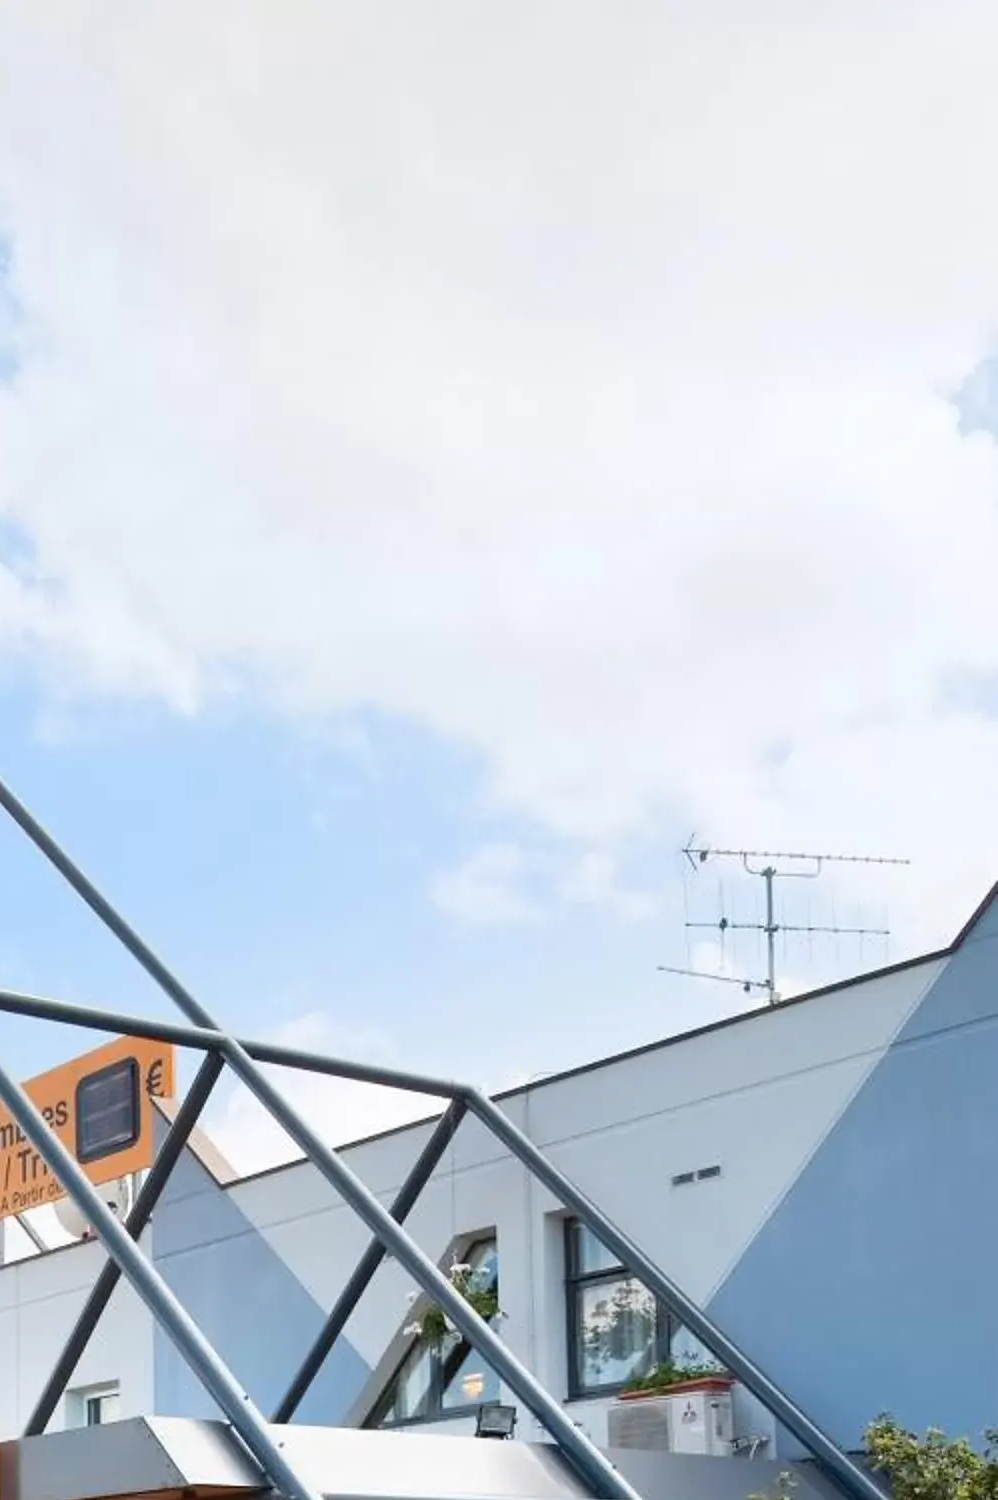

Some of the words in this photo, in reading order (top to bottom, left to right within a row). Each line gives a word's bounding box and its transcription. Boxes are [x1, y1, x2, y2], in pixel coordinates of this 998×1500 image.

[145, 1058, 164, 1097] €
[4, 1156, 11, 1191] /
[12, 1185, 45, 1208] Partir
